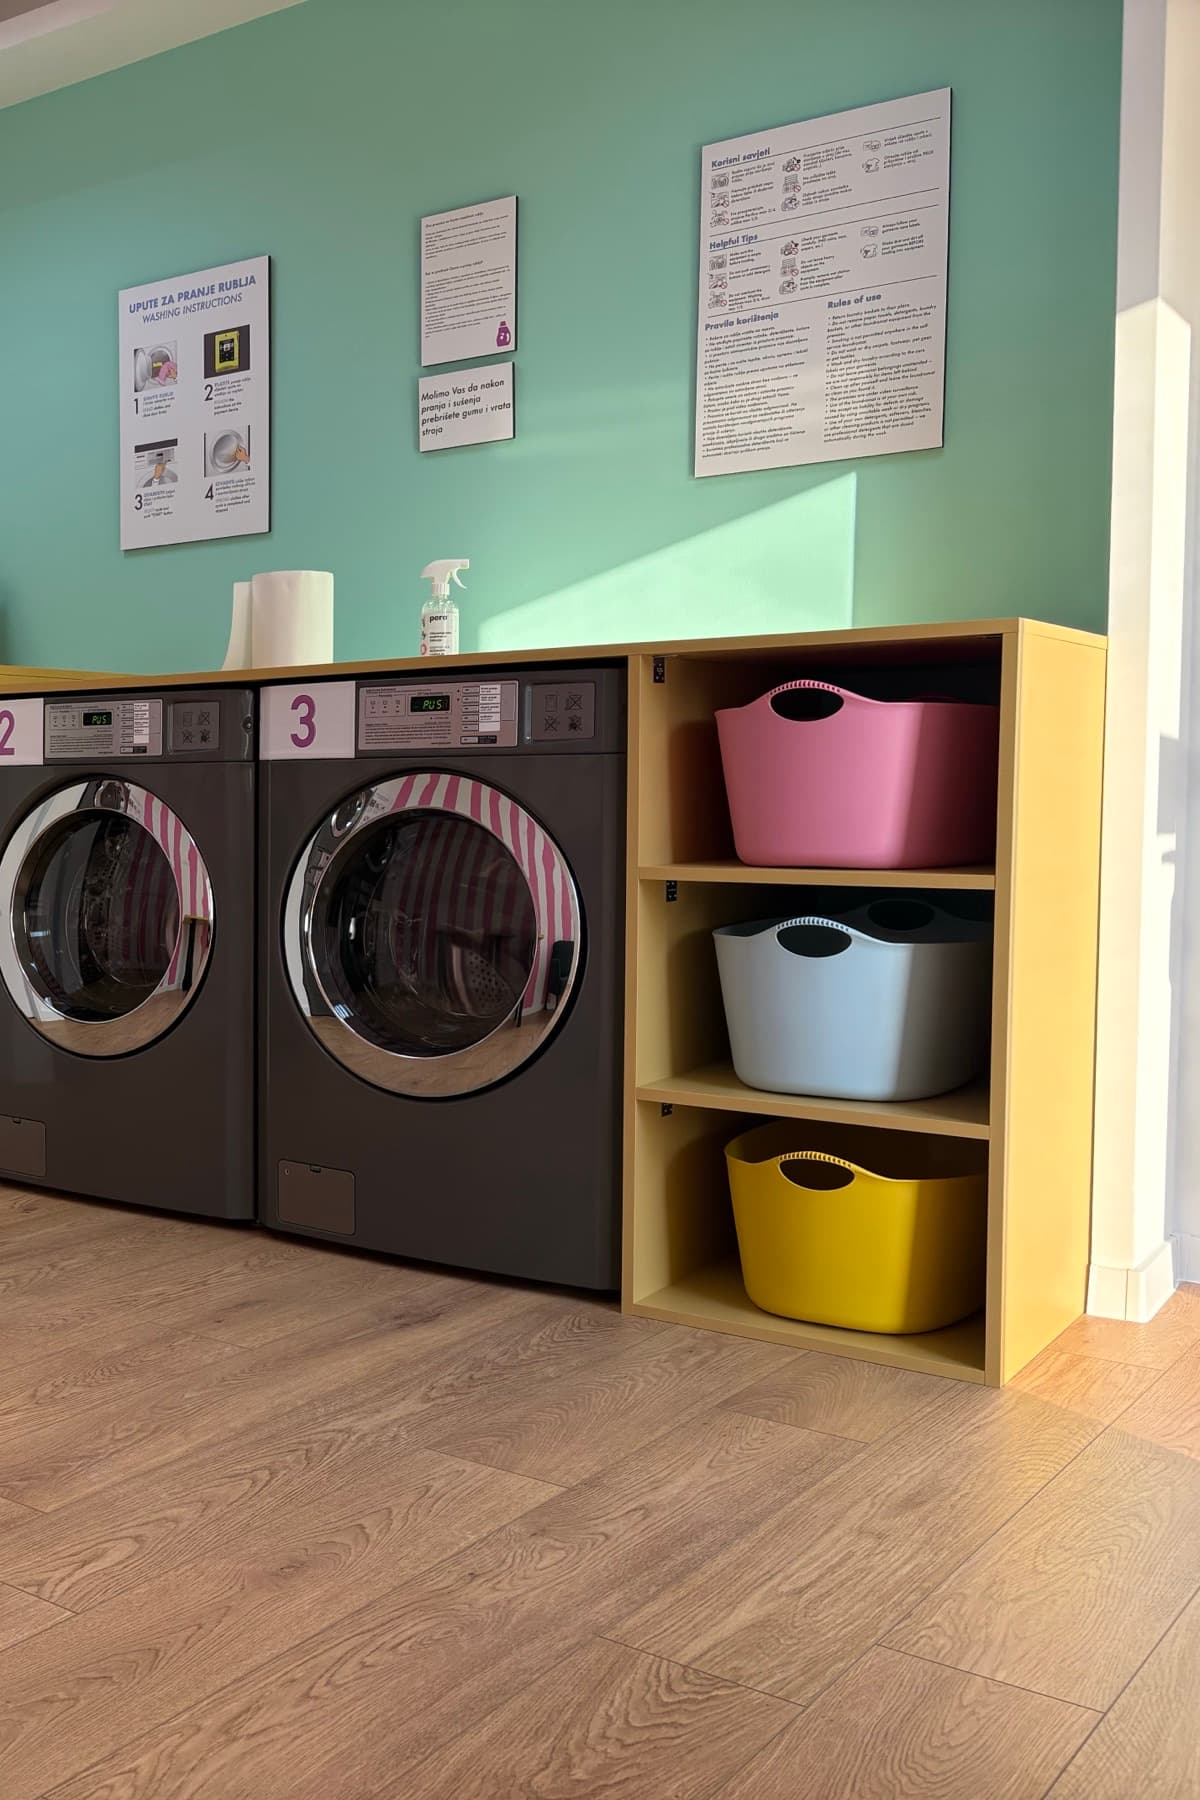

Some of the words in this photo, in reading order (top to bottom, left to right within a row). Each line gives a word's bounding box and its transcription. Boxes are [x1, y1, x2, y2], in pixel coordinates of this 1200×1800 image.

[711, 158, 740, 168] Korisni
[742, 148, 770, 160] savjeti
[710, 235, 739, 249] Helpful
[742, 234, 758, 243] Tips
[130, 299, 158, 313] UPUTE
[162, 296, 174, 306] ZA
[178, 285, 215, 302] PRANJE
[219, 276, 256, 291] RUBLJA
[828, 299, 851, 308] Rules
[143, 308, 180, 324] WASHING
[183, 293, 242, 314] INSTRUCTIONS
[705, 320, 734, 330] Pravila
[204, 384, 213, 401] 2
[421, 390, 449, 401] Molimo
[452, 387, 465, 395] Vas
[468, 384, 478, 392] da
[480, 379, 504, 389] nakon
[134, 398, 138, 414] 1
[421, 403, 446, 415] pranja
[453, 395, 480, 407] sušenja
[421, 412, 460, 426] prebrišete
[462, 408, 483, 419] gumu
[491, 402, 511, 411] vrata
[205, 484, 213, 500] 4
[134, 494, 142, 510] 3
[290, 694, 316, 748] 3
